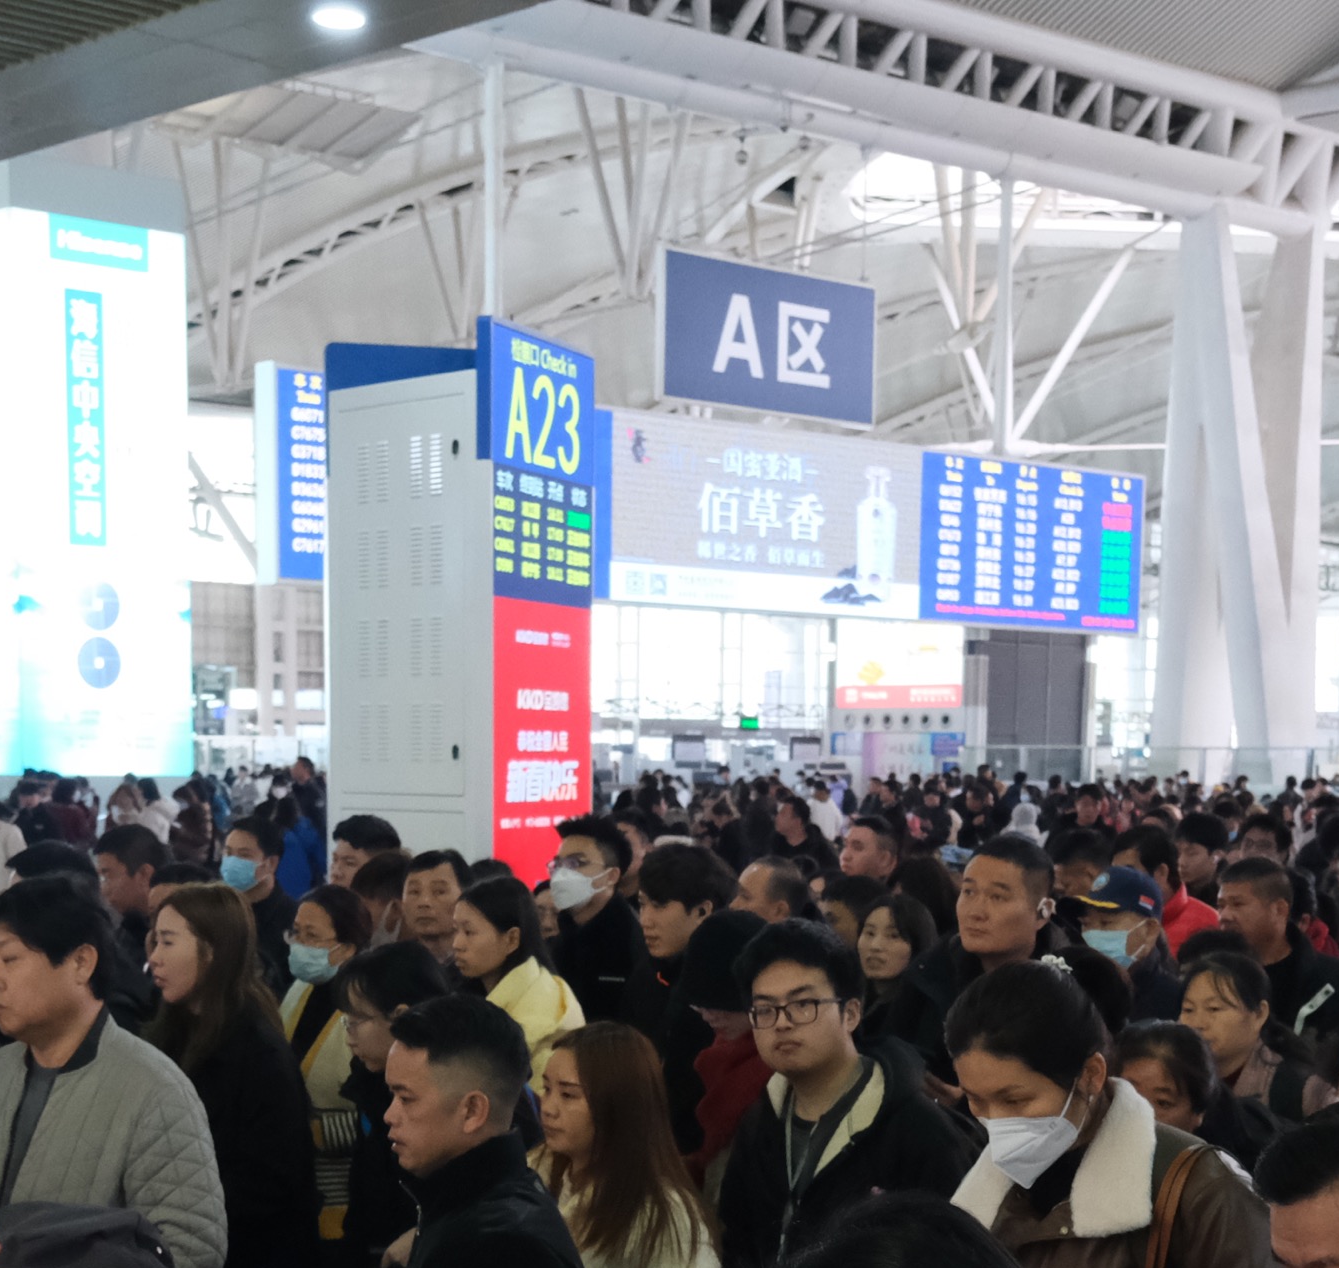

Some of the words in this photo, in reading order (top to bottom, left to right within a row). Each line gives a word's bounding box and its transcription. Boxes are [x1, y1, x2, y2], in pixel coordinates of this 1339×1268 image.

[505, 366, 580, 475] A23
[698, 482, 825, 542] 佰草香
